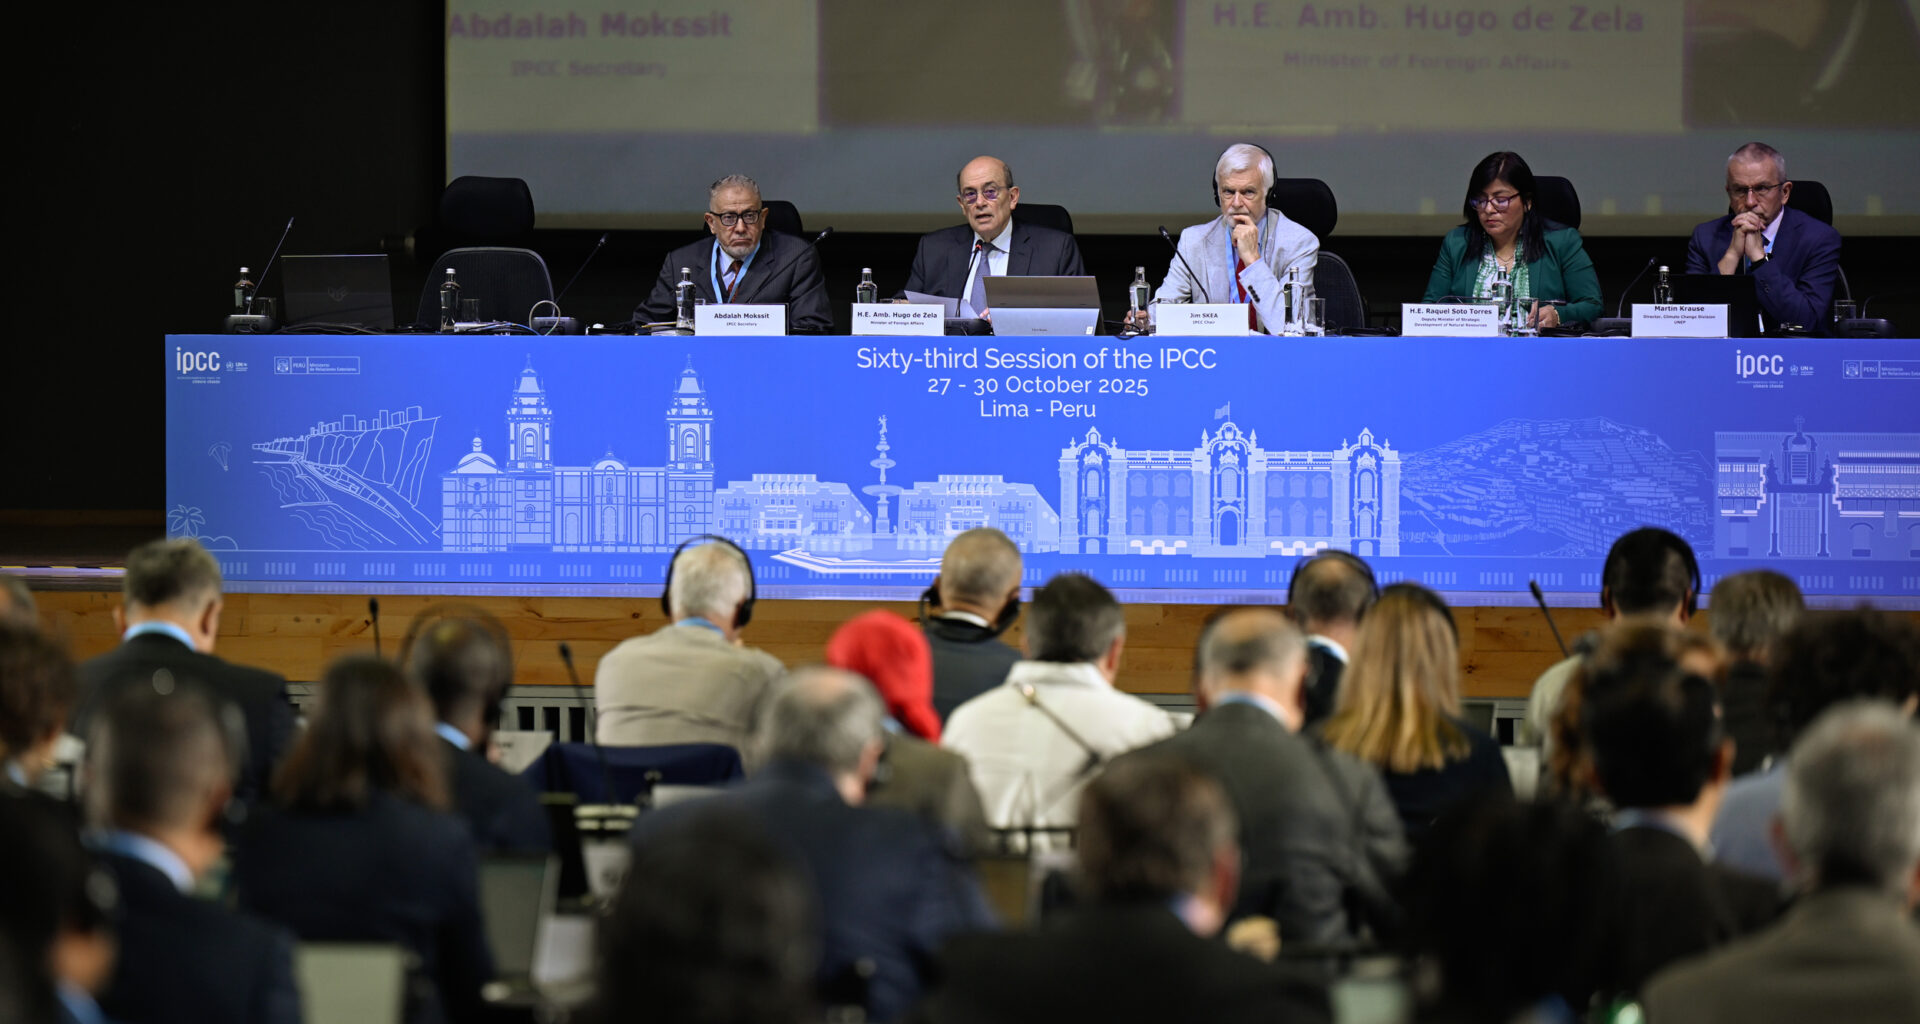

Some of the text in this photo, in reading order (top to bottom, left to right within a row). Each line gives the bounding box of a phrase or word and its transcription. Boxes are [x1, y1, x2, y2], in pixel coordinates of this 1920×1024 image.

[451, 10, 732, 38] Abdalah Mokssit
[1212, 4, 1645, 37] H.E. Amb. Hugo de Zela
[1284, 52, 1571, 73] Minister of Foreign Affairs
[892, 311, 911, 319] Hugo
[176, 346, 221, 375] ipcc
[856, 347, 1217, 374] Sixty-third Session of the IPCC
[1736, 349, 1784, 379] ipcc
[927, 377, 952, 395] 27
[973, 378, 999, 396] 30
[1005, 376, 1092, 394] October
[1098, 378, 1149, 397] 2025
[980, 400, 1029, 418] Lima
[1050, 400, 1097, 418] Peru
